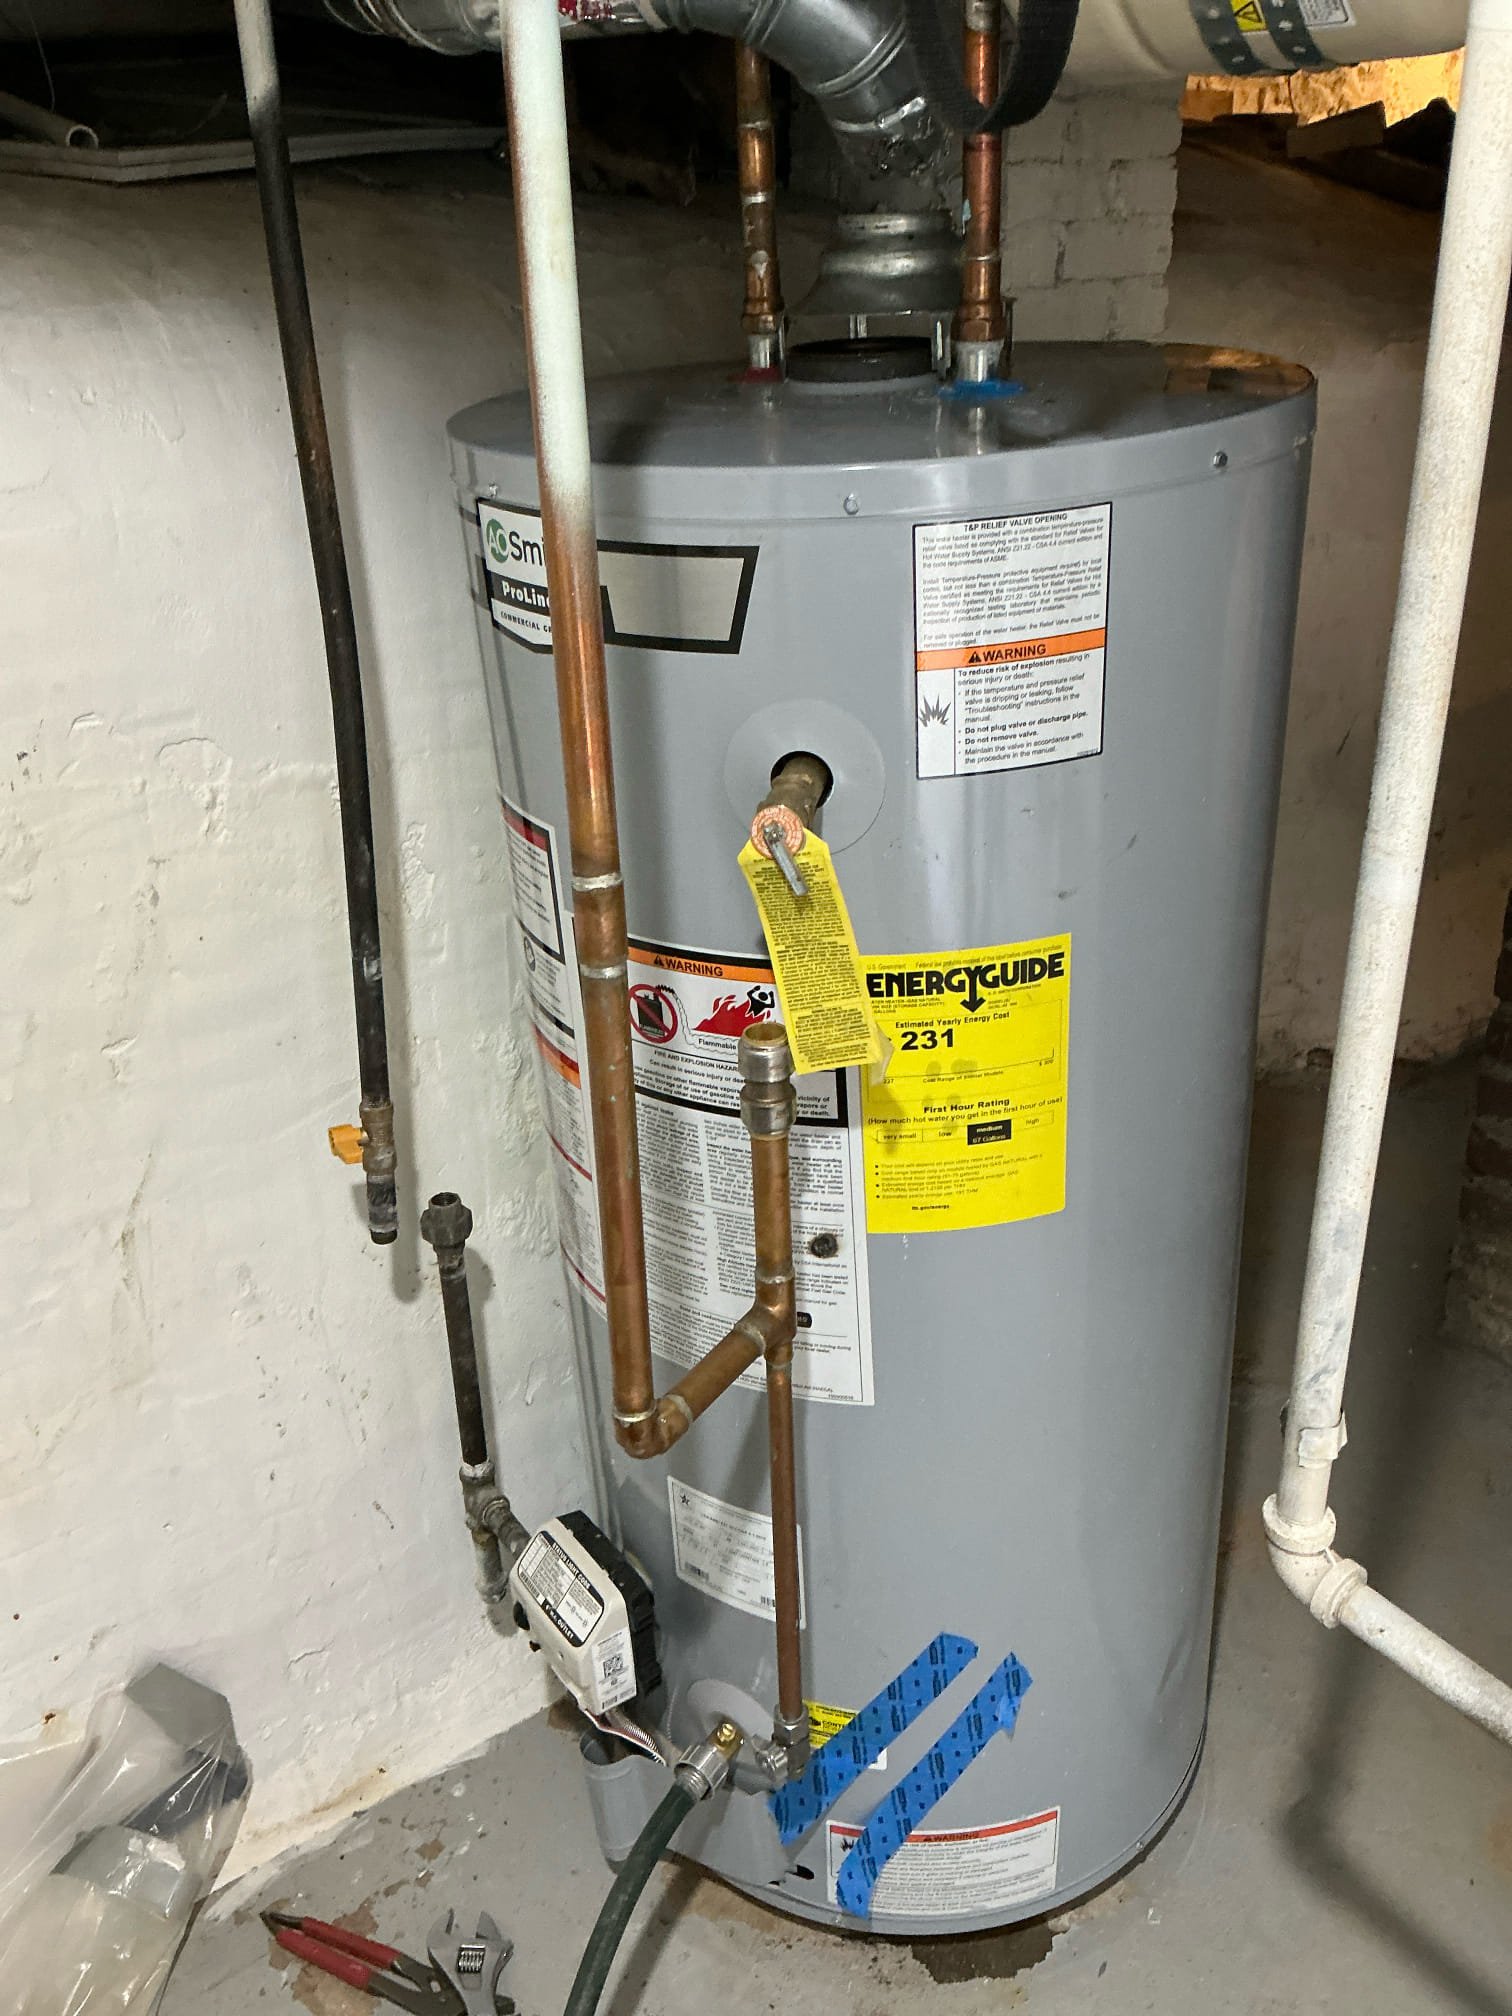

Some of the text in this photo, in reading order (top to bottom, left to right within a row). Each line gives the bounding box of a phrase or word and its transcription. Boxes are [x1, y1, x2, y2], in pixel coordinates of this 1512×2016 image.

[964, 513, 1067, 531] T&P RELIEF VALVE OPENING
[509, 530, 544, 566] Smi
[501, 610, 540, 630] COMMERCIAL
[984, 644, 1046, 662] WARNING
[1020, 660, 1054, 670] explosion
[1055, 655, 1082, 664] resulting
[983, 682, 1024, 692] temperature
[1039, 676, 1068, 686] pressure
[991, 692, 1019, 701] dripping
[1024, 696, 1062, 705] instructions
[964, 714, 991, 722] manual.
[990, 723, 1006, 732] plug
[1037, 714, 1070, 723] discharge
[1072, 712, 1088, 720] pipe.
[964, 744, 993, 754] Maintain
[1033, 733, 1070, 743] accordance
[977, 752, 1011, 763] procedure
[666, 958, 723, 977] WARNING
[866, 952, 1065, 1003] ENERGYGUIDE
[895, 1011, 1009, 1028] Estimated Yearly Energy Cost
[698, 1038, 737, 1050] Flammable
[901, 1029, 954, 1050] 231
[681, 1056, 714, 1067] EXPLOSION
[643, 1067, 664, 1078] gasoline
[688, 1079, 718, 1090] flammable
[684, 1068, 705, 1076] serious
[706, 1072, 722, 1081] injury
[654, 1076, 674, 1087] Storage
[709, 1090, 734, 1098] gasoline
[663, 1086, 672, 1095] any
[689, 1093, 716, 1103] appliance
[868, 1118, 887, 1126] (How
[950, 1113, 965, 1122] you
[966, 1110, 979, 1120] get
[1003, 1104, 1018, 1113] first
[1019, 1102, 1037, 1110] hour
[1047, 1096, 1062, 1105] use)
[923, 1104, 946, 1113] First
[977, 1099, 1009, 1108] Rating
[982, 1134, 1006, 1142] Gallons
[552, 1542, 567, 1562] STATUS
[566, 1559, 579, 1577] LIGHT
[557, 1619, 574, 1639] OUTLET
[934, 1832, 979, 1842] WARNING
